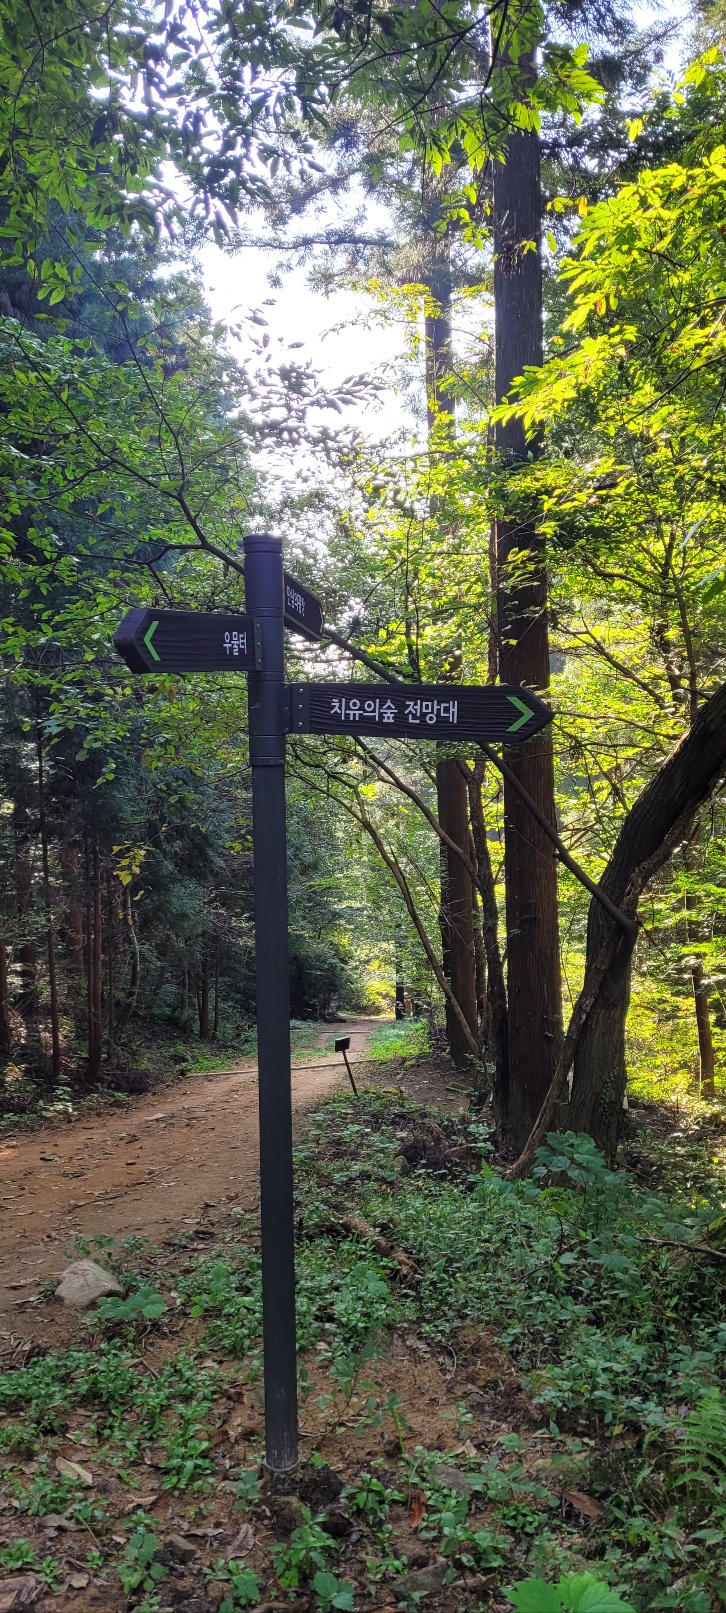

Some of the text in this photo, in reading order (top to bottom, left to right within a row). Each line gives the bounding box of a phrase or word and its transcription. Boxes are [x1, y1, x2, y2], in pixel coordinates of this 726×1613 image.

[223, 631, 247, 656] 우물터
[329, 699, 458, 724] 치유의숲 전망대
